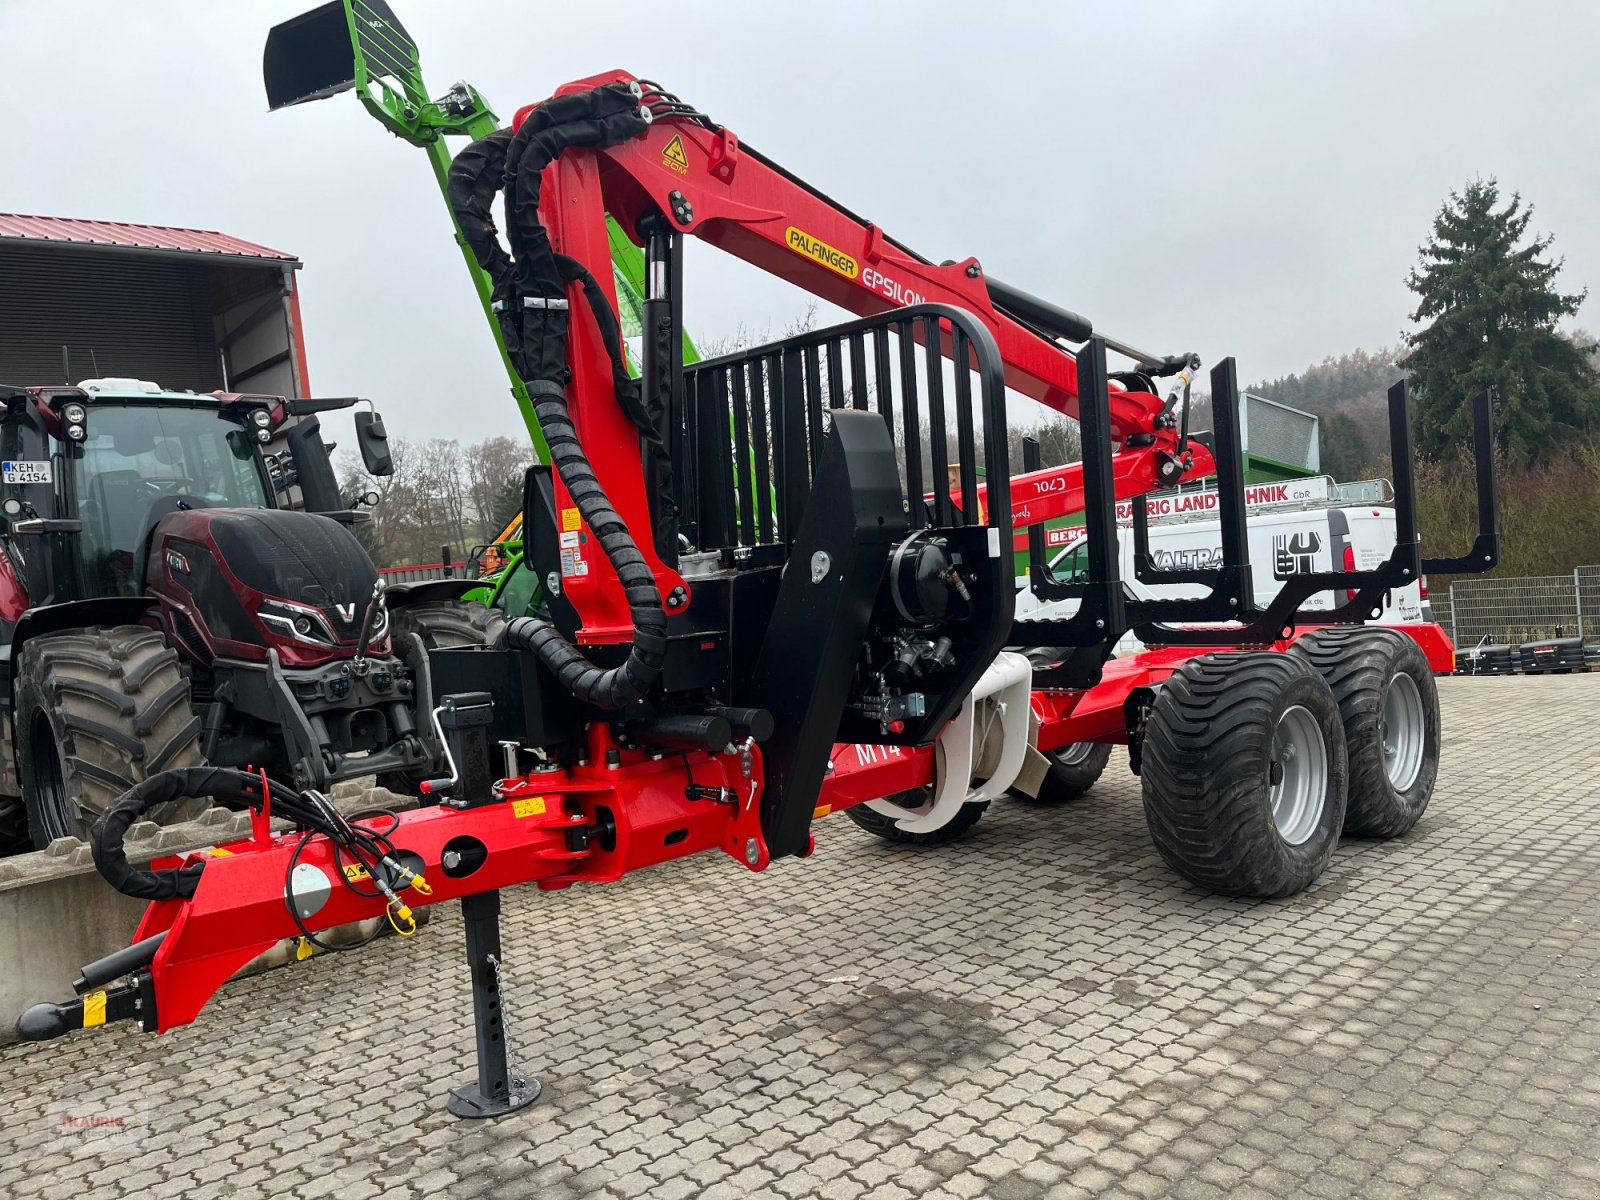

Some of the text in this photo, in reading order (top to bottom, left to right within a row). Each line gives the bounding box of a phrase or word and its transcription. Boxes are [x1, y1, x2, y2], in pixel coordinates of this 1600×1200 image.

[789, 230, 855, 276] PALFINGER
[862, 267, 926, 305] EPSILON
[11, 463, 34, 473] KEH
[8, 472, 47, 482] G 4154
[1033, 477, 1066, 493] C70L
[1293, 490, 1310, 500] GbR
[1152, 547, 1224, 568] VALTRA
